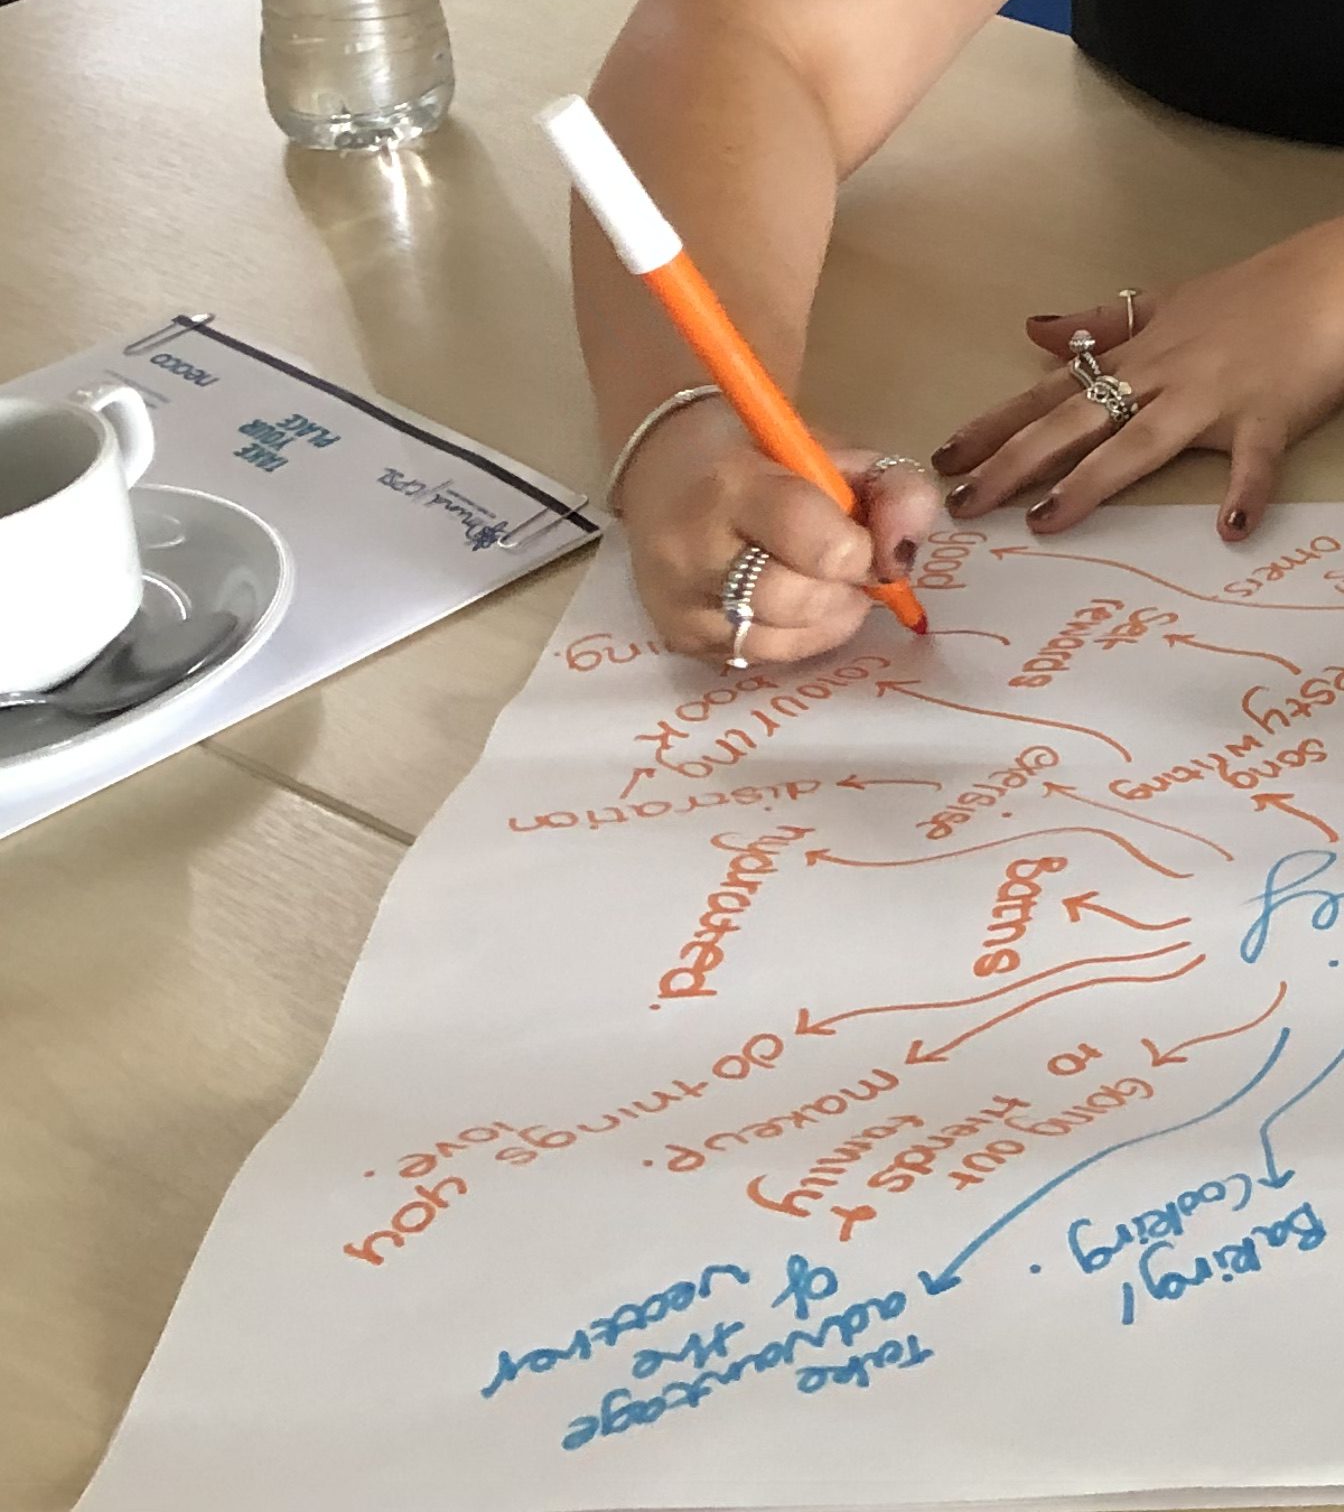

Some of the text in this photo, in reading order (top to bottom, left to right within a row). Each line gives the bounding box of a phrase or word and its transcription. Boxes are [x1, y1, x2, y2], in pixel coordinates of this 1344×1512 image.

[150, 353, 220, 389] neaco
[232, 442, 290, 473] TAKE
[237, 419, 299, 450] YOUR
[276, 413, 342, 449] PLACE
[1007, 598, 1124, 689] rewards
[1108, 733, 1261, 801] writing
[1212, 737, 1329, 792] song
[973, 855, 1069, 978] Baths
[1047, 1042, 1105, 1078] to
[343, 1033, 785, 1266] do things you
[746, 1114, 926, 1218] family
[948, 1076, 1155, 1192] Going out
[770, 1253, 839, 1320] of
[561, 1290, 908, 1452] advantage the
[797, 1334, 936, 1395] Take
